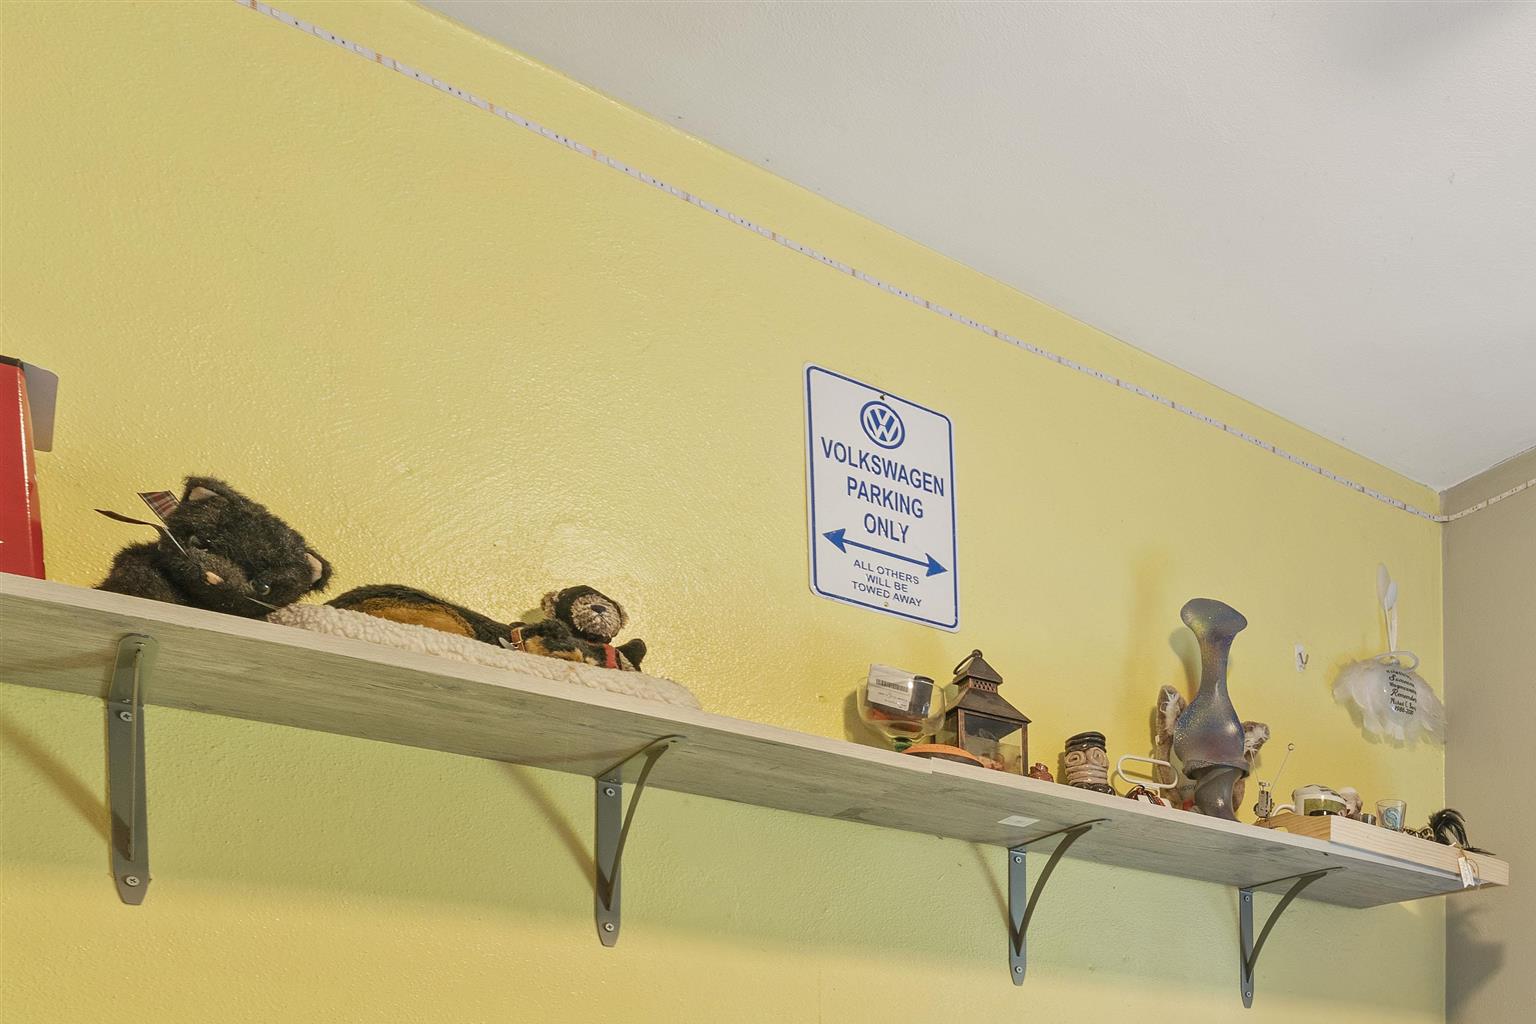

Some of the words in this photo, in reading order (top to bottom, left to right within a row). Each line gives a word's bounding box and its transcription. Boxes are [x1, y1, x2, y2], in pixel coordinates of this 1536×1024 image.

[821, 436, 945, 498] VOLKSWAGEN
[847, 476, 924, 519] PARKING
[864, 513, 910, 544] ONLY
[853, 559, 874, 573] ALL
[876, 565, 920, 585] OTHERS
[865, 573, 891, 588] WILL
[894, 581, 909, 593] BE
[851, 581, 890, 599] TOWED
[893, 592, 922, 607] AWAY
